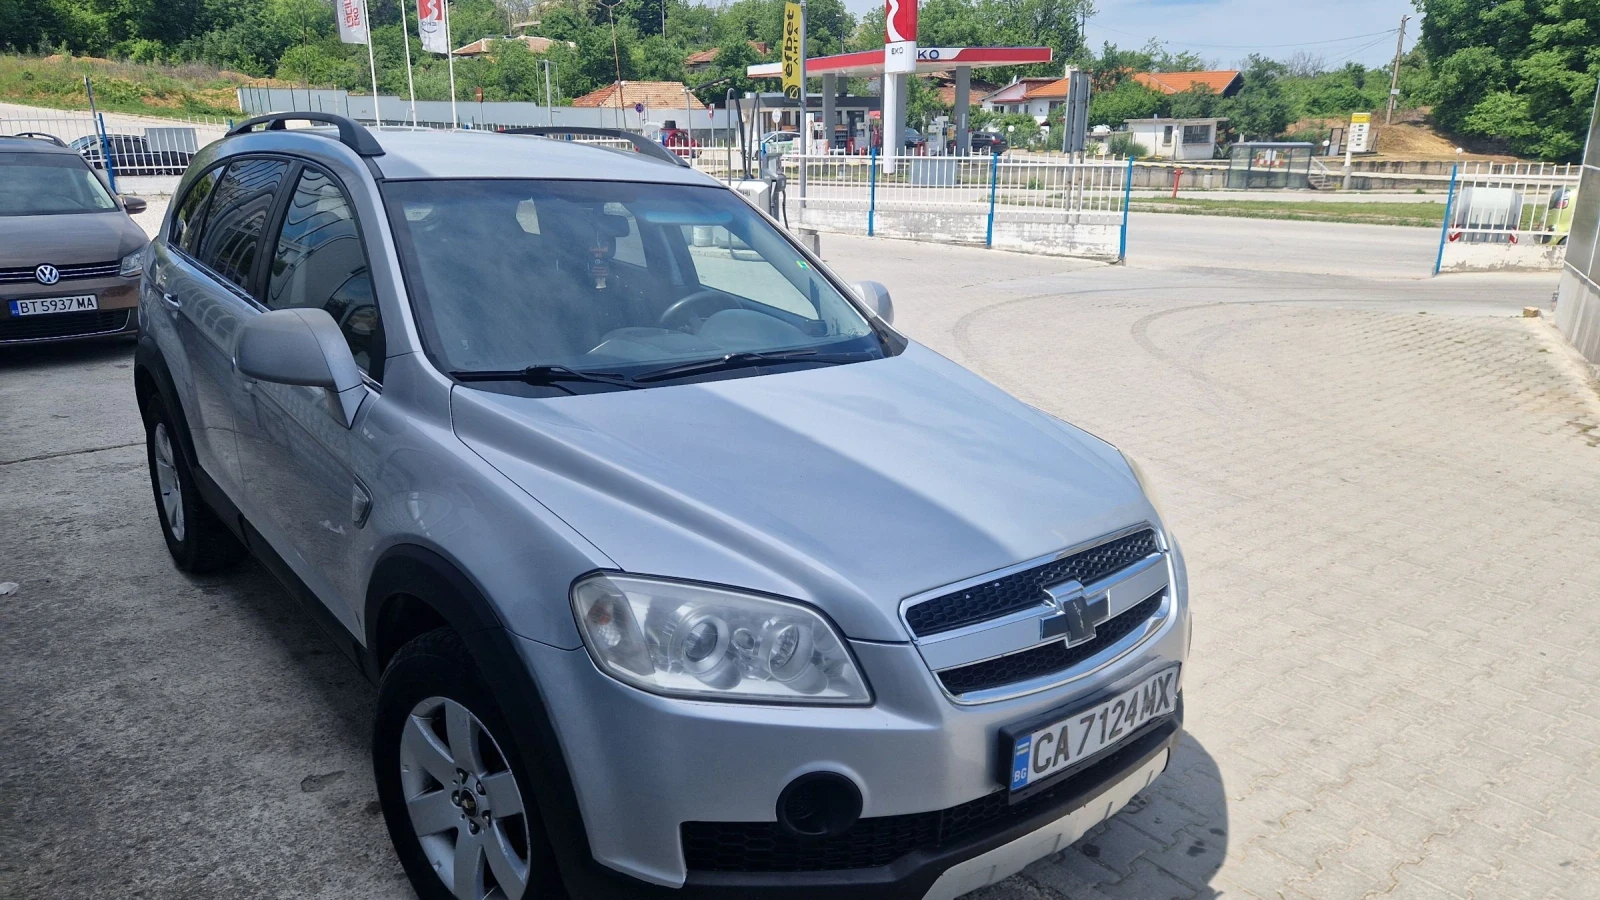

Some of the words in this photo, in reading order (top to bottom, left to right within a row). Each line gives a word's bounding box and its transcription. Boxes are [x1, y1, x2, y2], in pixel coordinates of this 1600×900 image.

[784, 10, 794, 77] efbet
[891, 46, 904, 55] EKO
[917, 49, 940, 60] KO
[20, 301, 38, 314] BT
[41, 299, 74, 312] 5937
[77, 297, 94, 309] MA
[1033, 725, 1070, 774] CA
[1076, 690, 1140, 756] 7124
[1140, 672, 1173, 721] MX
[1013, 767, 1027, 783] BG
